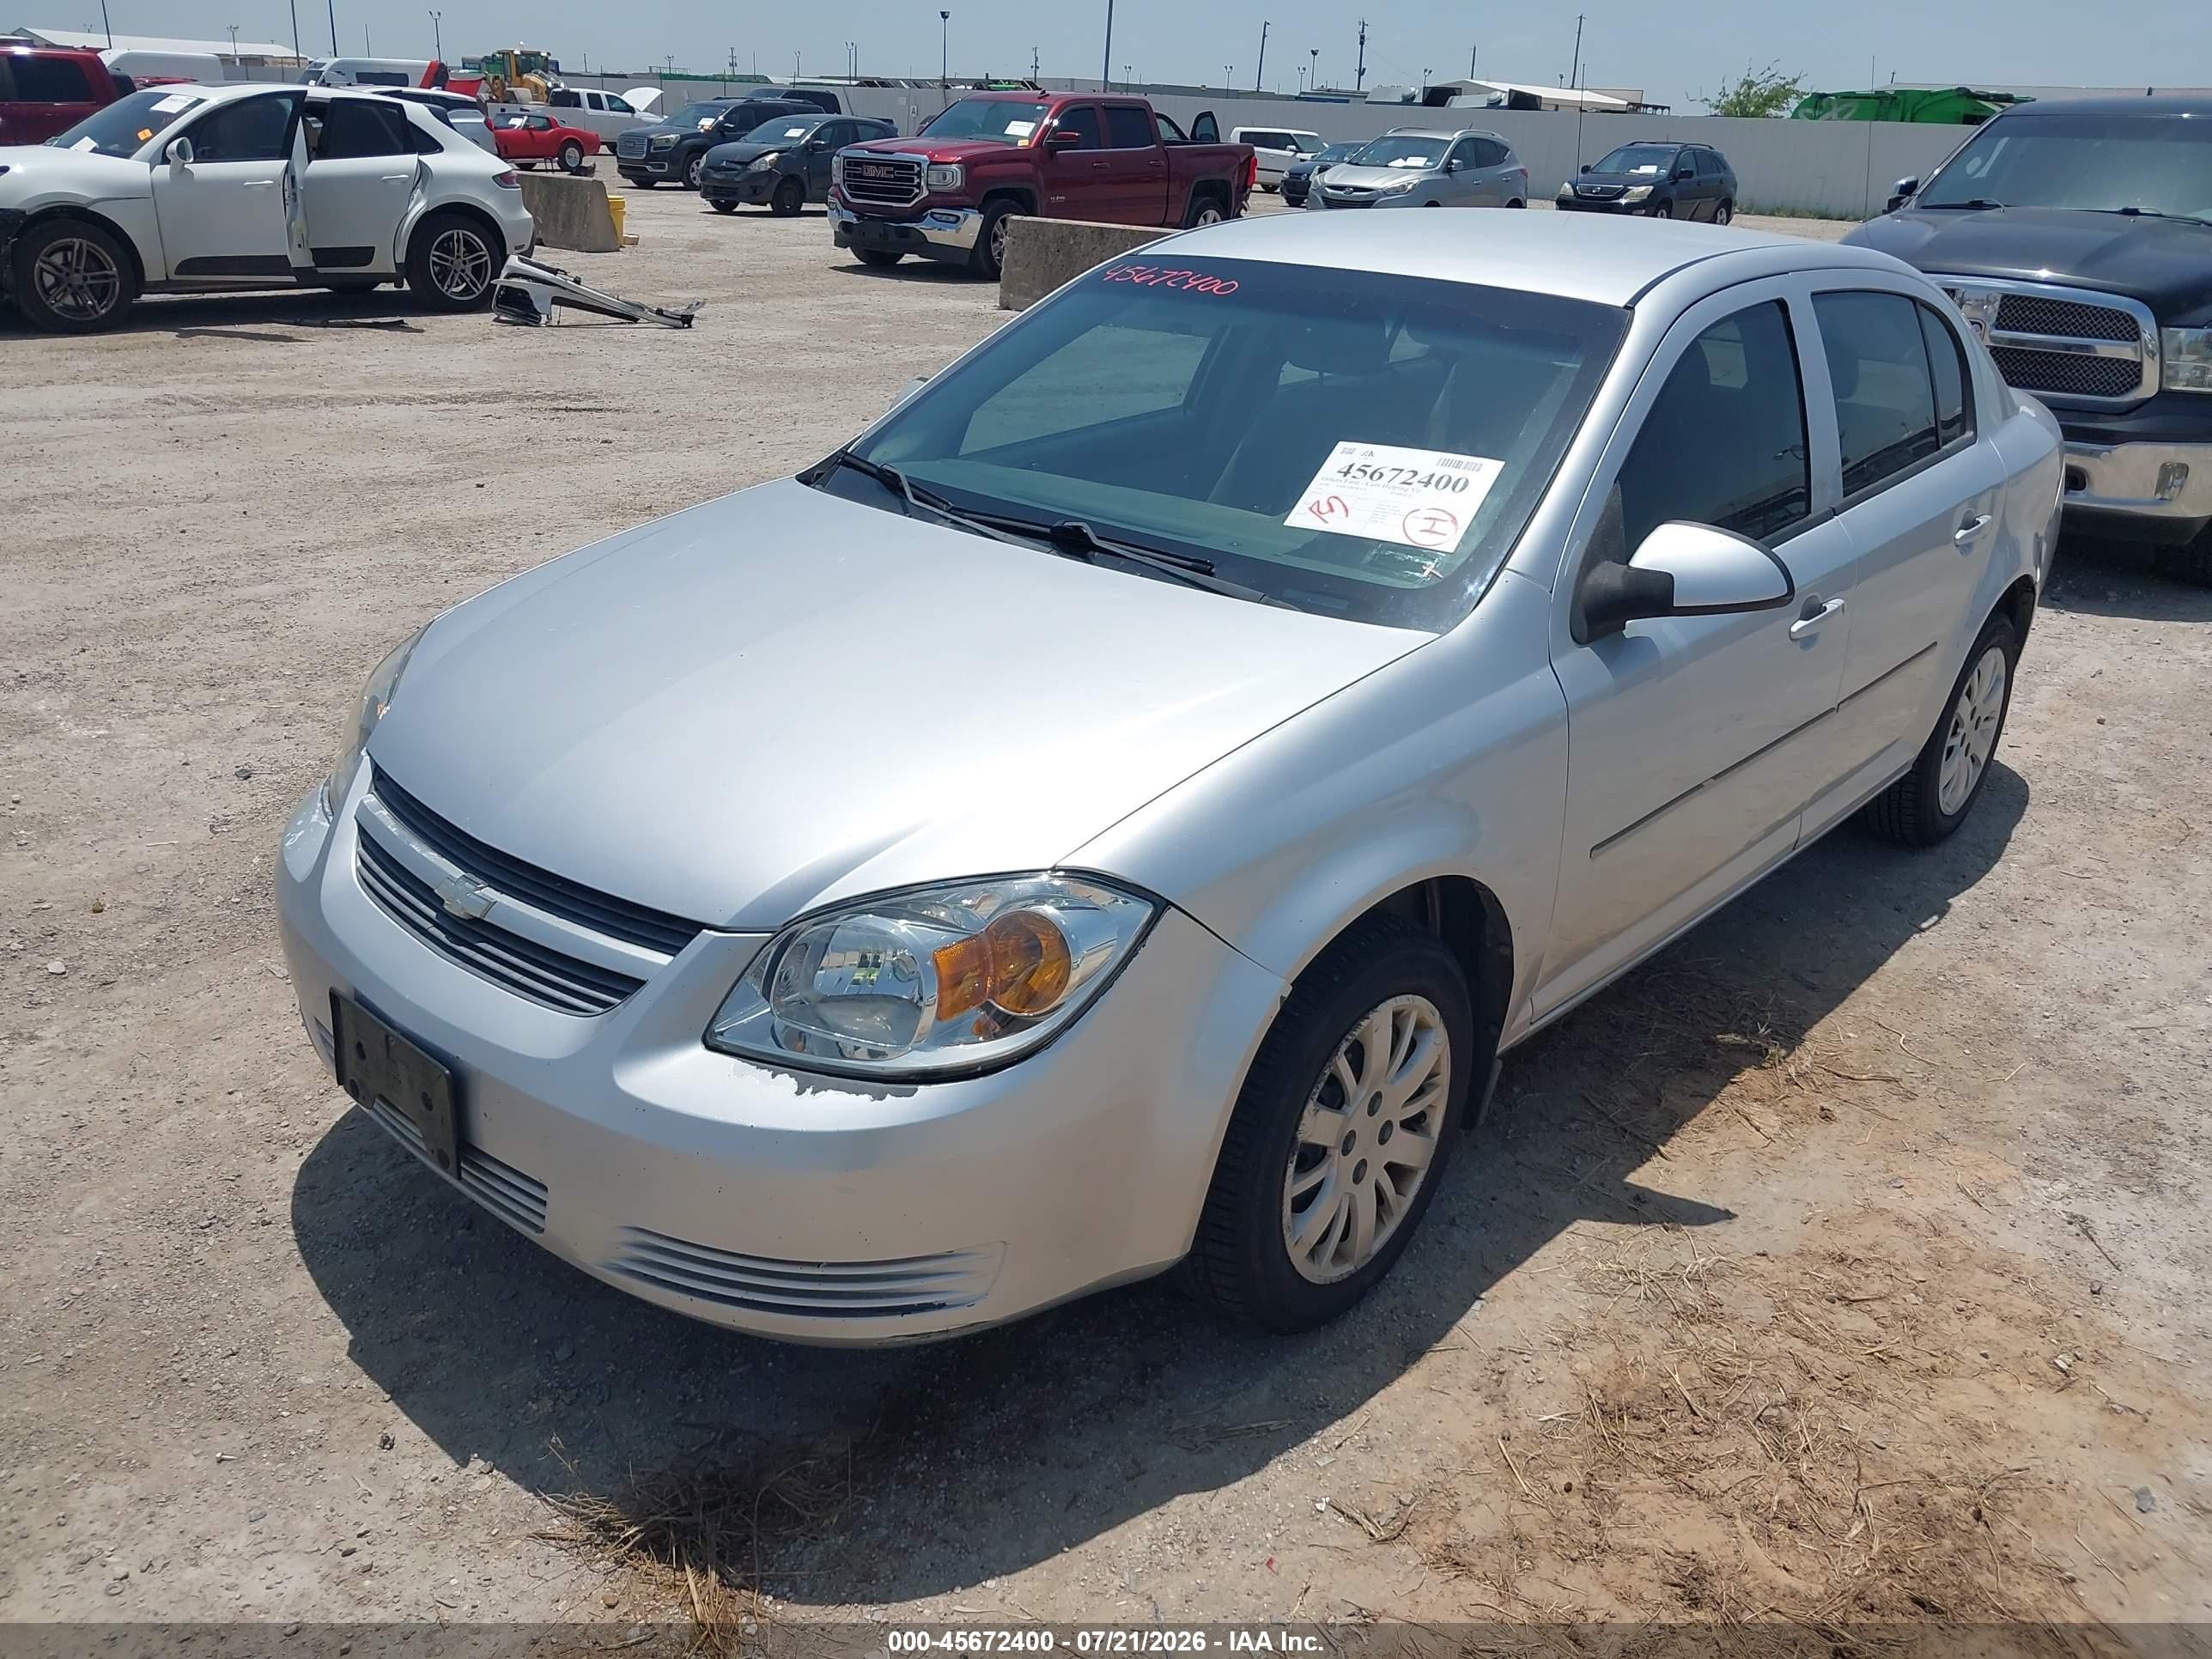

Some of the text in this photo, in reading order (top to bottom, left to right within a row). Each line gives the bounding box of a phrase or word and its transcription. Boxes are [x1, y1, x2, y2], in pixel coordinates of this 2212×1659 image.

[862, 165, 894, 179] GMC
[1103, 264, 1239, 295] 45672400
[1336, 462, 1469, 494] 45672400
